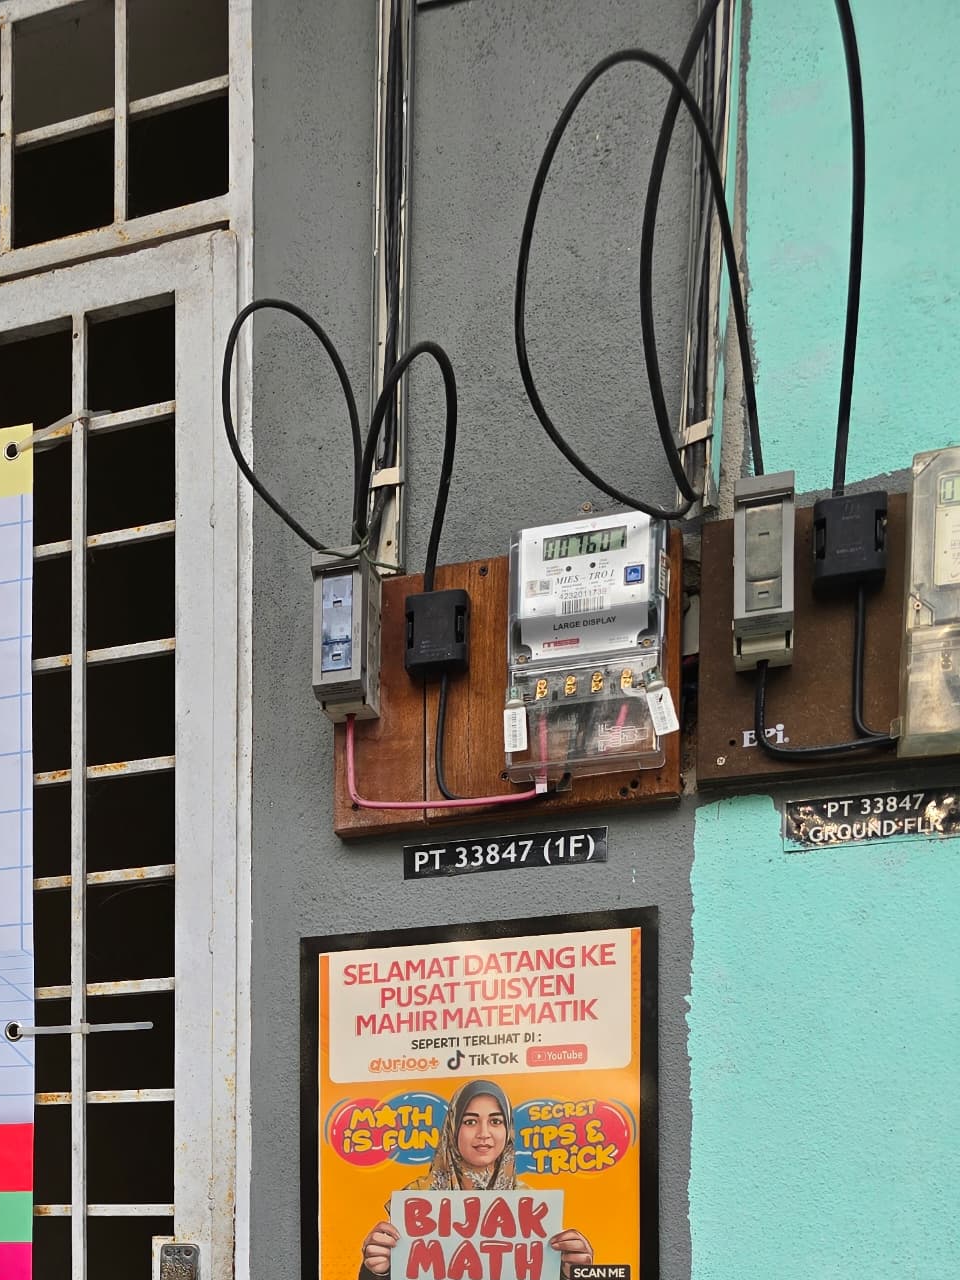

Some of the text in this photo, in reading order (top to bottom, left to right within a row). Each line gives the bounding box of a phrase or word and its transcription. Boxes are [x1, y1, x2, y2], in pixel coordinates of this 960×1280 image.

[553, 616, 616, 630] LARGE DISPLAY
[827, 794, 925, 818] PT 33847
[809, 820, 897, 842] GROUND
[414, 834, 595, 872] PT 33847 (1F)
[343, 943, 616, 985] SELAMAT DATANG KE
[381, 974, 575, 1008] PUSAT TUISYEN
[355, 999, 598, 1036] MAHIR MATEMATIK
[412, 1033, 521, 1049] SEPERTI TERLIHAT
[469, 1050, 583, 1066] TikTok YouTube
[404, 1197, 548, 1239] BIJAK
[574, 1267, 626, 1278] SCAN ME
